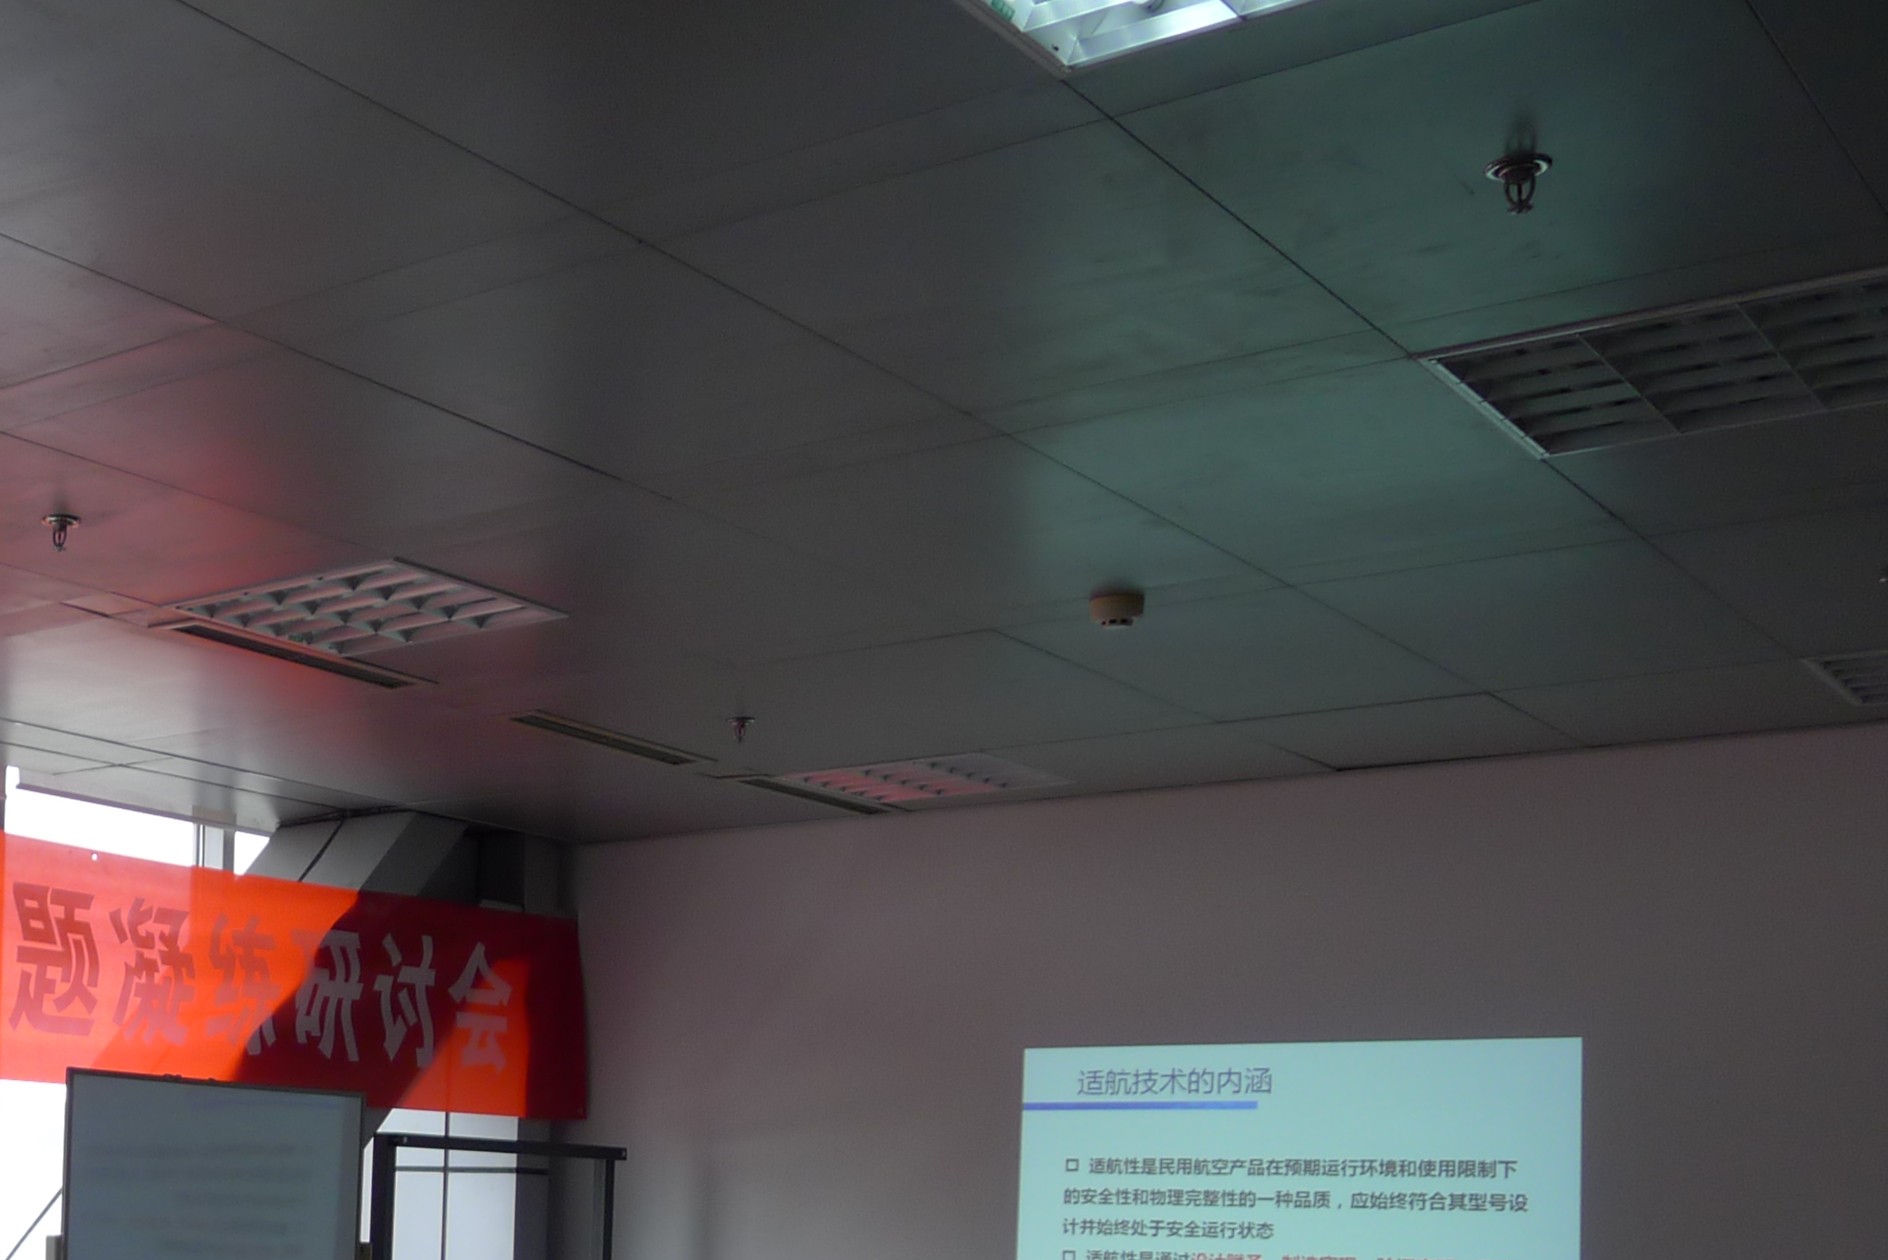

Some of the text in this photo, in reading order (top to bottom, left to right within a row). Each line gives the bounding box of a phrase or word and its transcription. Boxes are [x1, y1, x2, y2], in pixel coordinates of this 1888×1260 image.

[1077, 1067, 1273, 1096] 适航技术的内涵
[1088, 1157, 1518, 1180] 适航性是民用航空产品在预期运行环境和使用限制下
[1062, 1218, 1275, 1240] 计并始终处于安全运行状态
